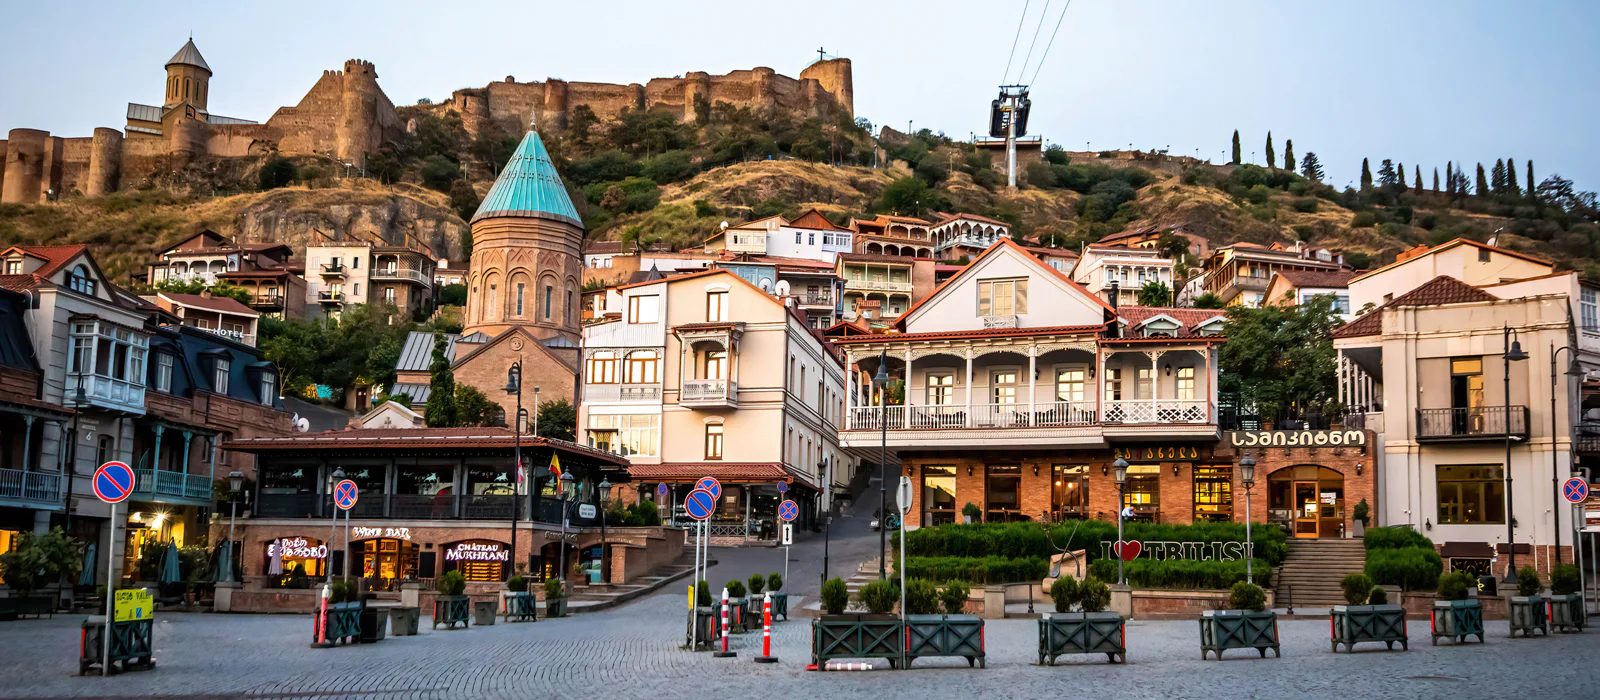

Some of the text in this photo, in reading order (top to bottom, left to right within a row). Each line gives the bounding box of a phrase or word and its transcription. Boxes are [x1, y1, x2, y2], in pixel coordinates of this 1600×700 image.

[213, 328, 245, 338] HOTEL
[86, 431, 92, 441] 6
[1231, 430, 1365, 446] სამიკიტნო
[352, 526, 411, 539] WINE BAR
[446, 549, 510, 561] MUKHRANI
[1100, 541, 1254, 562] I TBILISI
